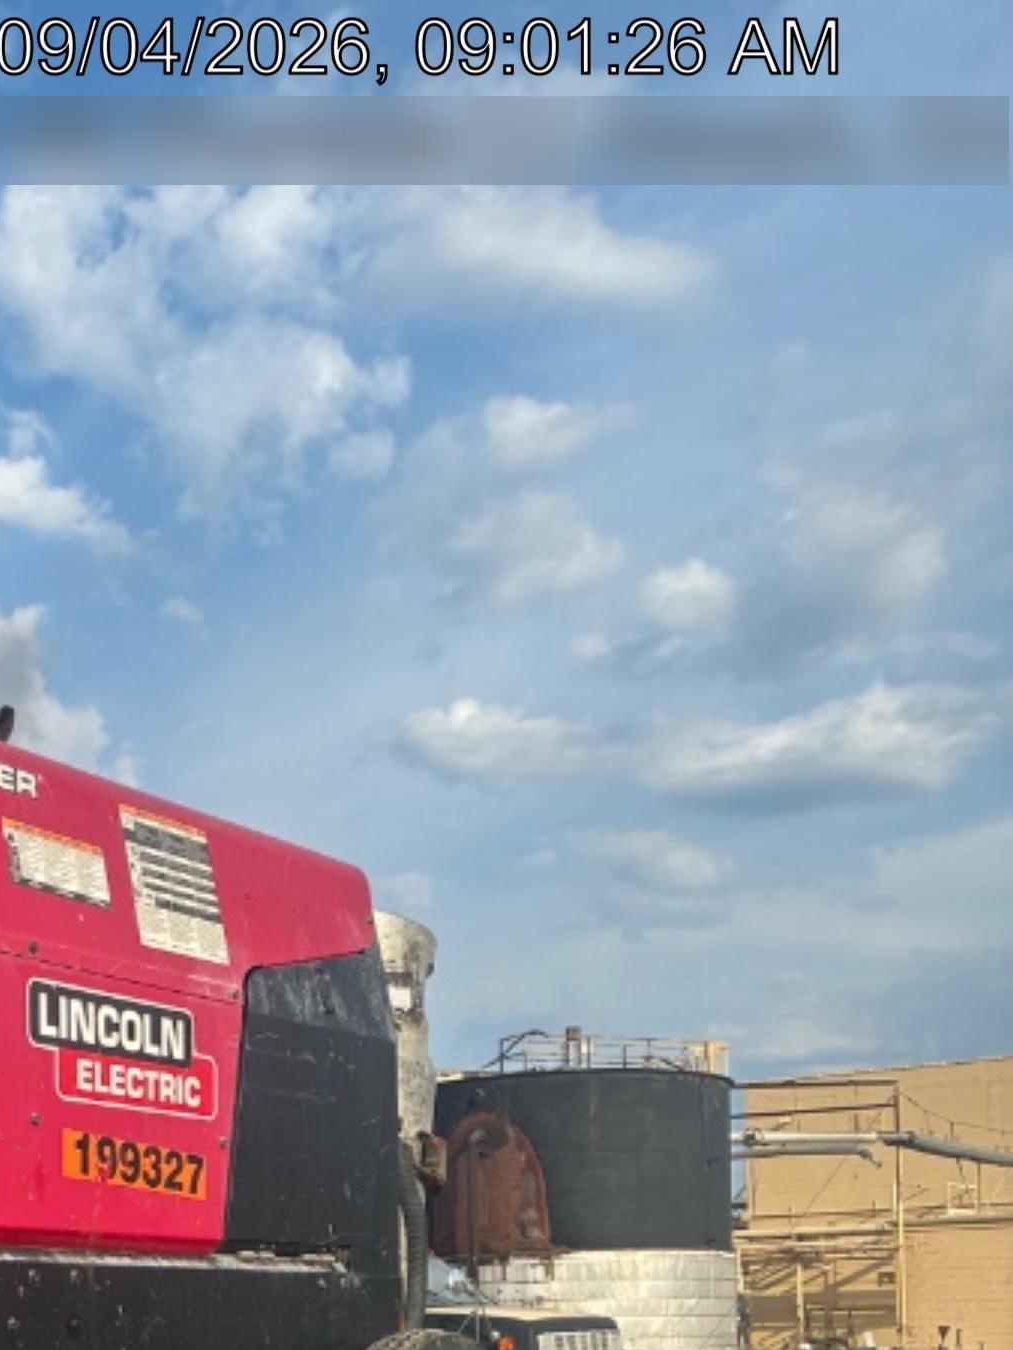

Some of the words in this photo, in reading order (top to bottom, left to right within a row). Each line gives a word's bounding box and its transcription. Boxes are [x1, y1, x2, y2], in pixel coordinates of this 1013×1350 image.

[38, 992, 185, 1060] LINCOLN
[76, 1058, 201, 1107] ELECTRIC
[76, 1132, 204, 1194] 199327
